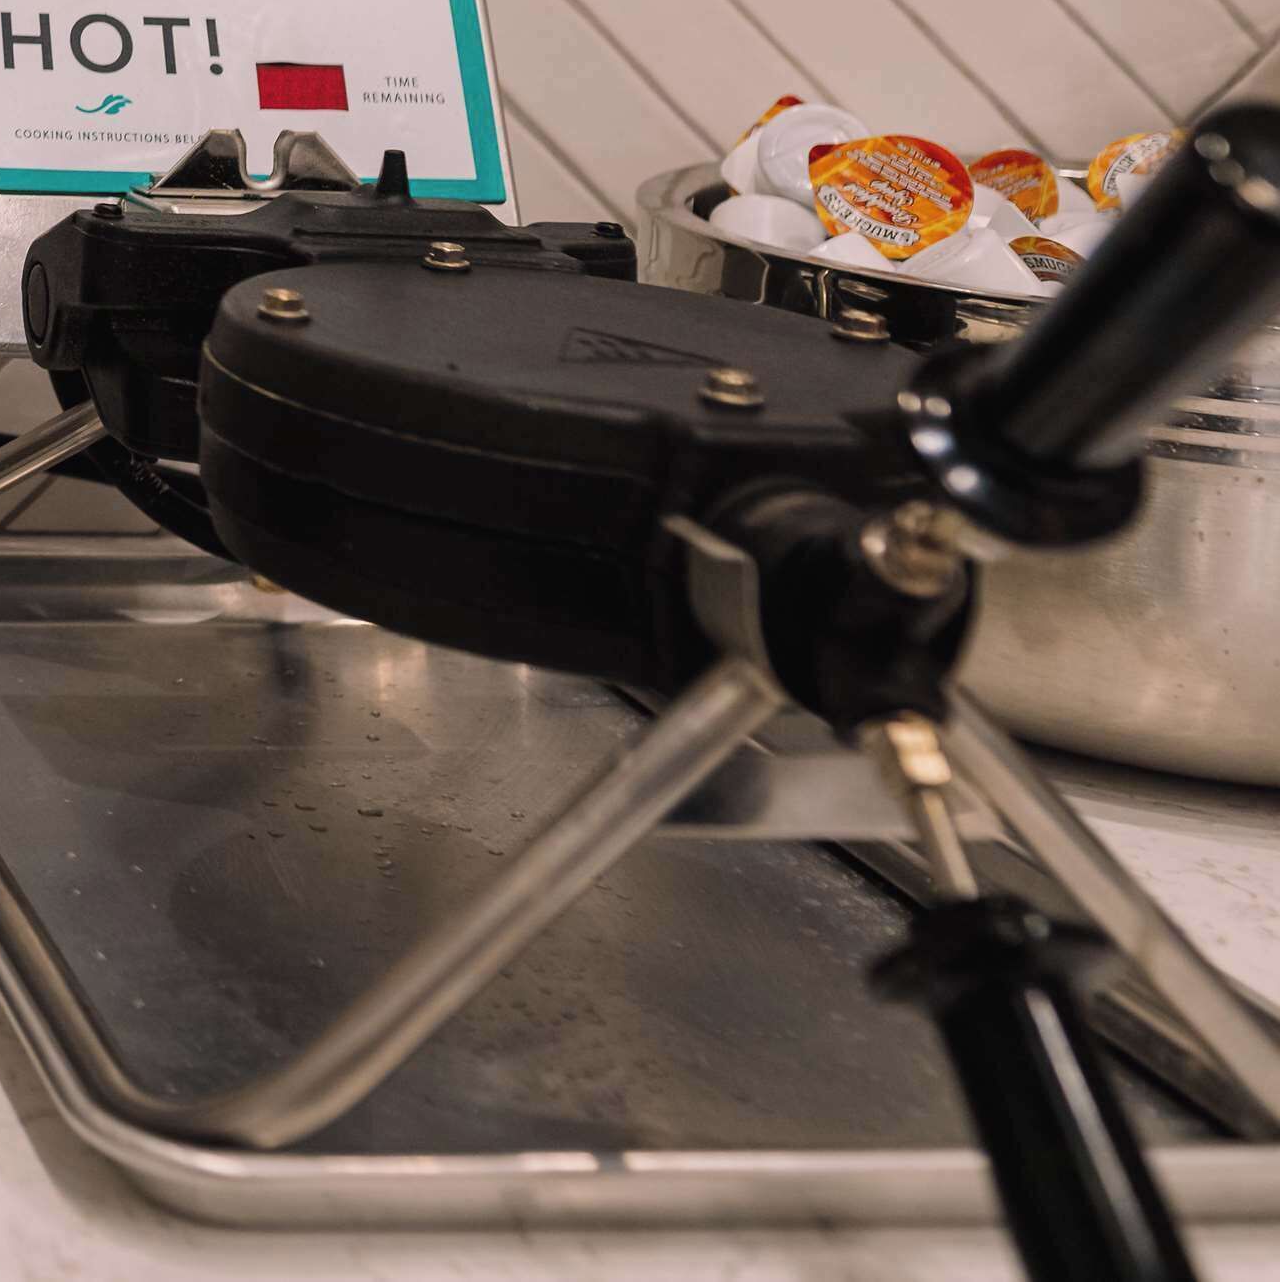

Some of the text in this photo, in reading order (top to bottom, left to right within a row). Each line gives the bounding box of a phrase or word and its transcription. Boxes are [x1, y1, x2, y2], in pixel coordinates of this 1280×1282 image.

[0, 11, 224, 75] HOT!
[385, 76, 418, 87] TIME
[363, 92, 445, 104] REMAINING
[15, 128, 73, 141] COOKING
[78, 131, 169, 143] INSTRUCTIONS
